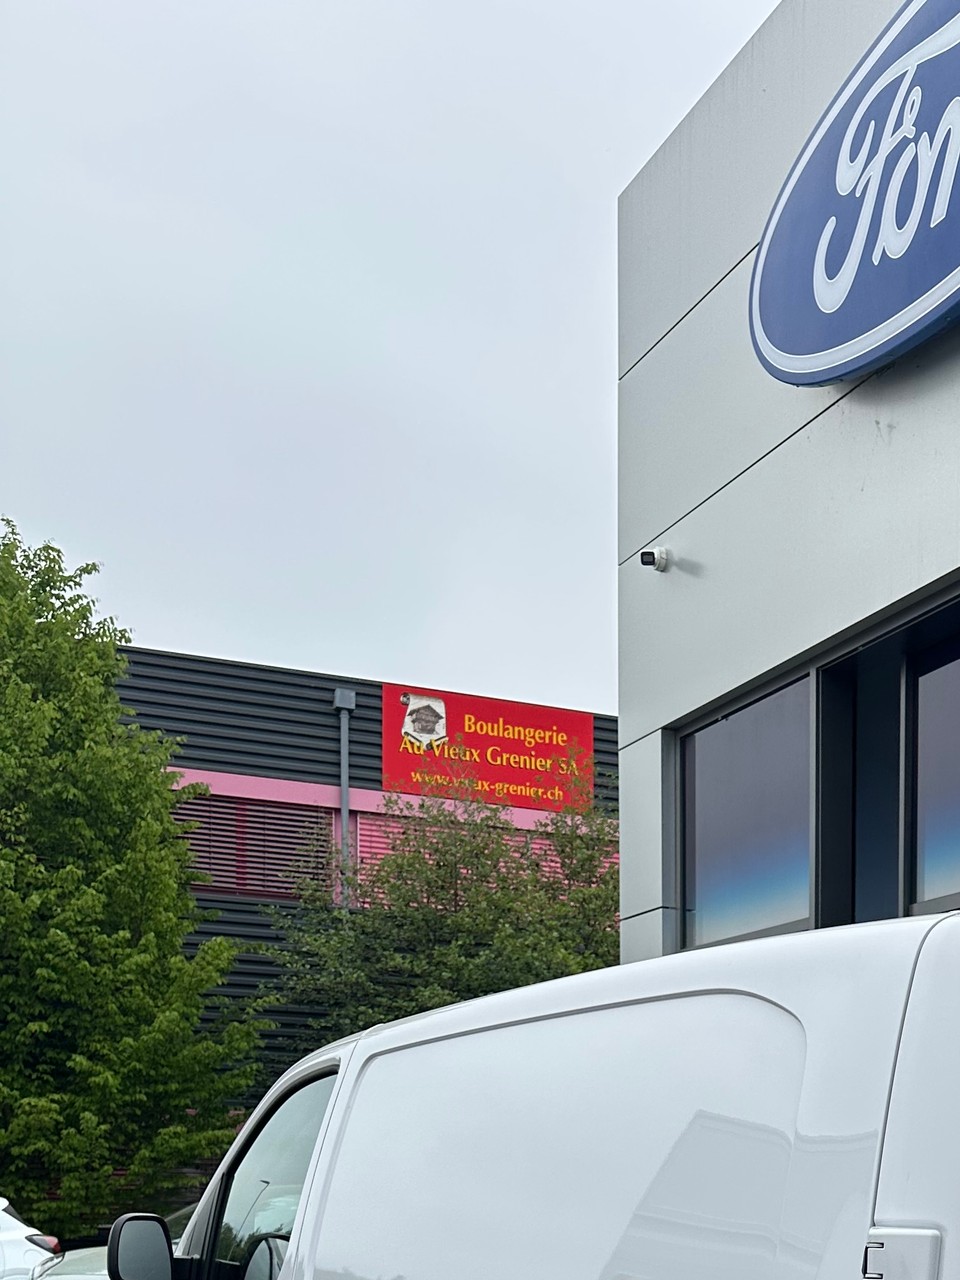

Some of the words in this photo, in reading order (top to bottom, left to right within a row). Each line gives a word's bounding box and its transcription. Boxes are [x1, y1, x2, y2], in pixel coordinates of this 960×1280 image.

[464, 713, 568, 748] Boulangerie
[399, 736, 424, 756] Au
[429, 738, 481, 763] Vieux
[486, 746, 553, 772] Grenier
[558, 757, 580, 776] SA
